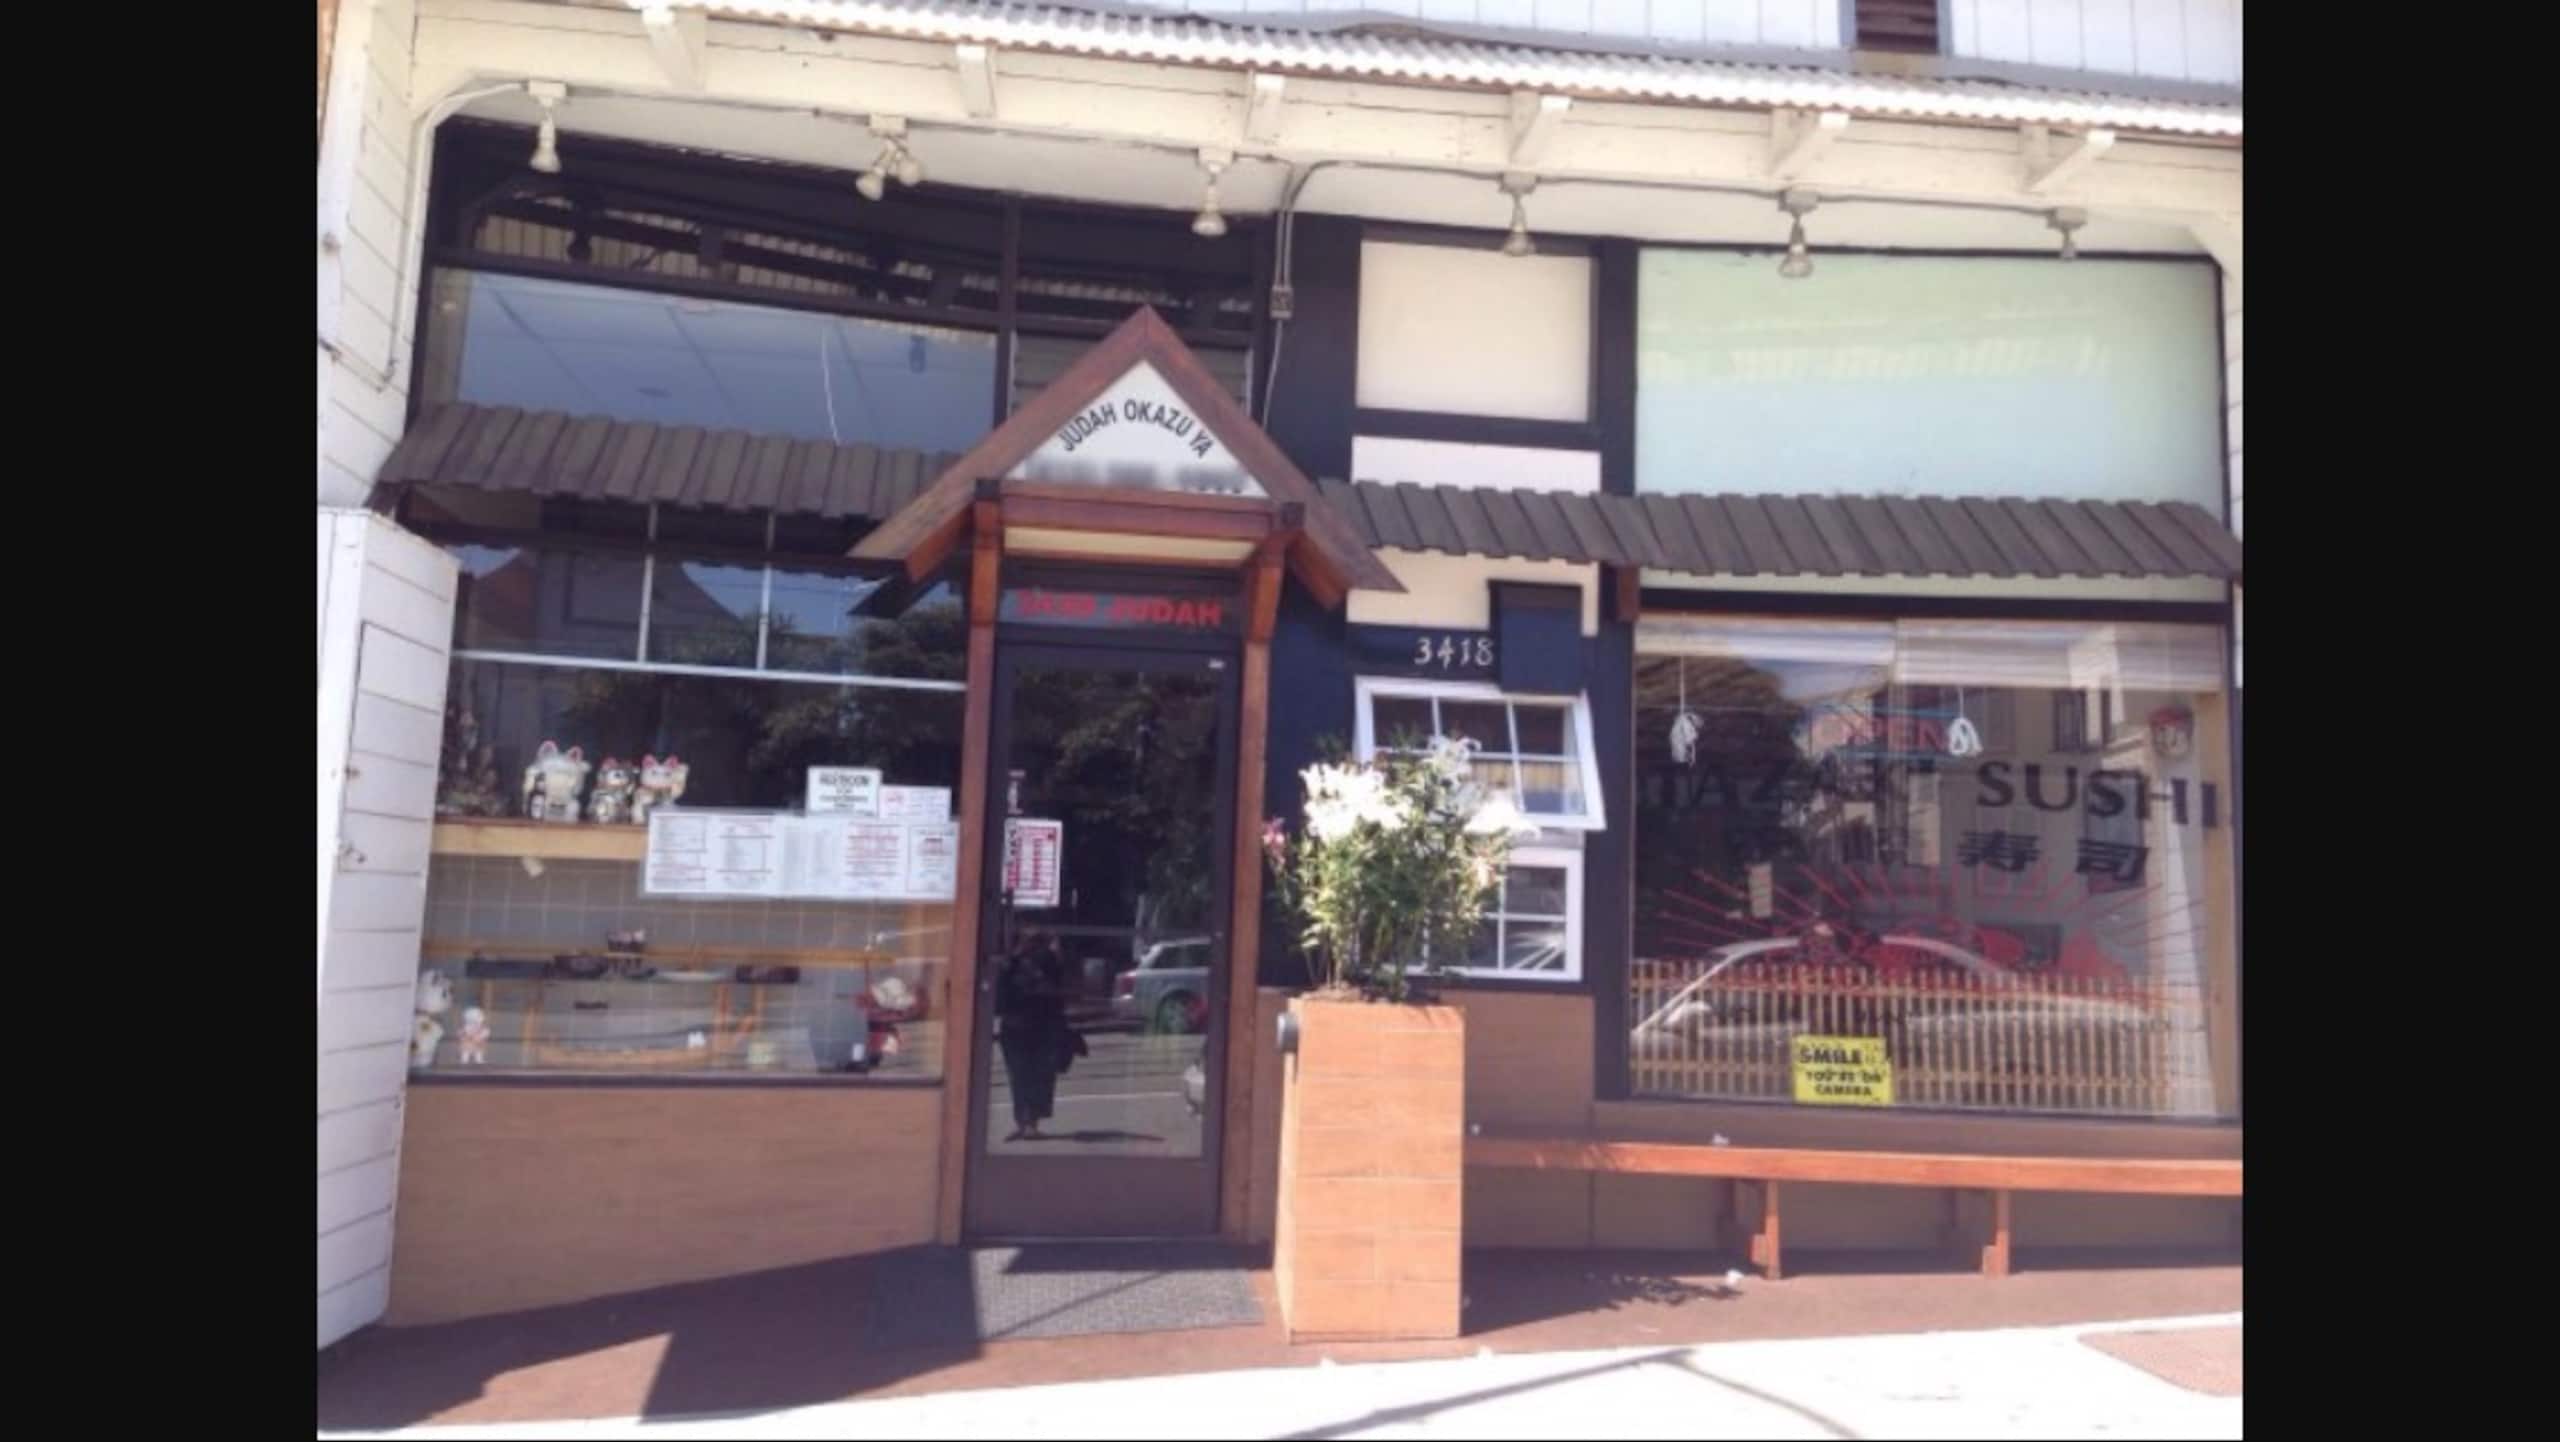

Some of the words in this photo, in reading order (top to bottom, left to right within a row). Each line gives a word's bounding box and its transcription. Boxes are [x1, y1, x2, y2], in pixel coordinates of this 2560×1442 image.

[1059, 403, 1118, 452] JUDAH
[1123, 399, 1193, 438] OKAZU
[1188, 430, 1214, 460] YA
[1413, 634, 1494, 672] 3418
[1976, 760, 2218, 828] SUSHI
[1799, 1046, 1862, 1065] SMILE
